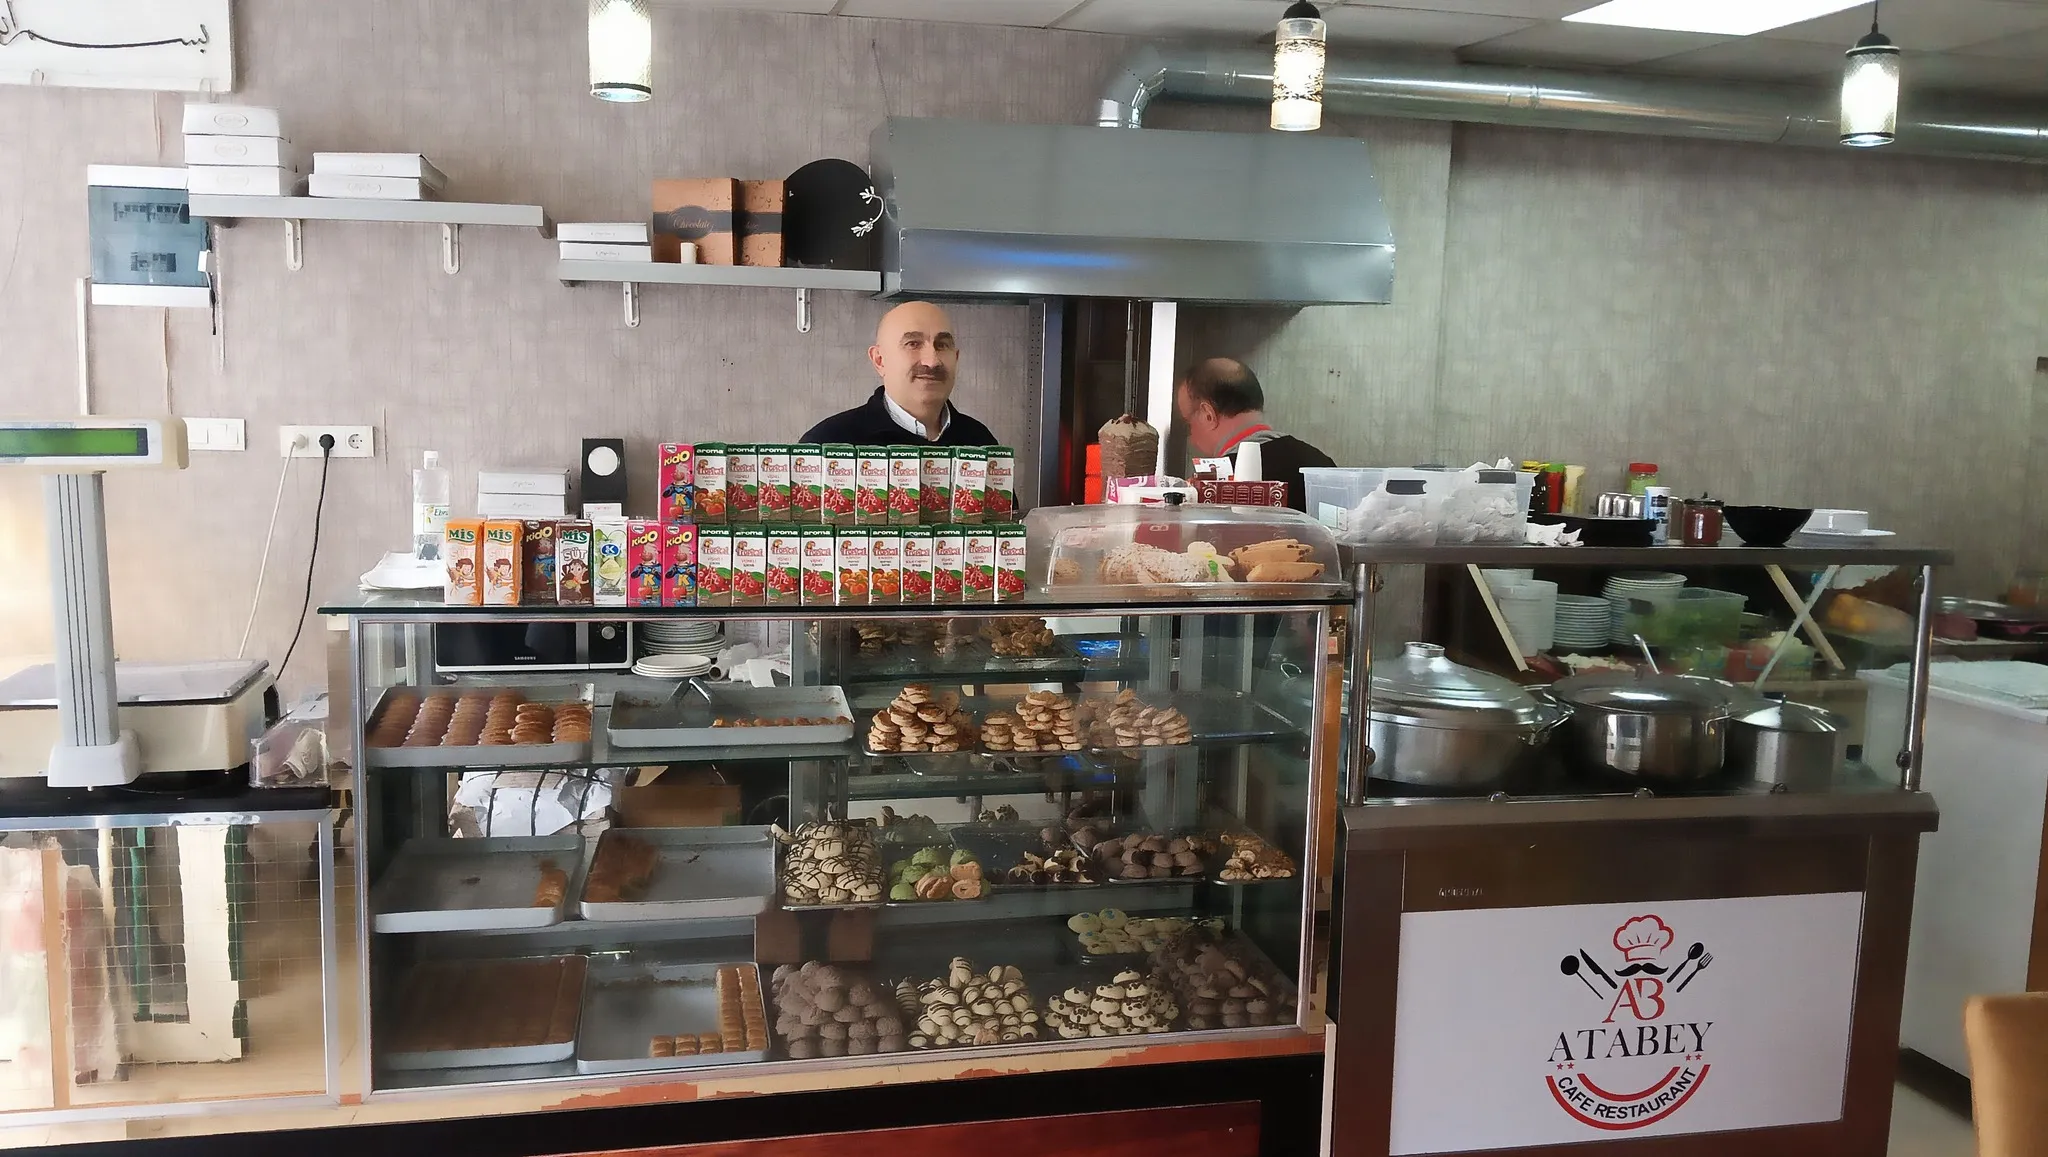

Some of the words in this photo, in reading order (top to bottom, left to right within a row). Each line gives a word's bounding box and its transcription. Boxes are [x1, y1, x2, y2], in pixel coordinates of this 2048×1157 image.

[1602, 977, 1665, 1024] AB
[1547, 1021, 1714, 1062] ATABEY
[1558, 1076, 1594, 1112] CAFE
[1593, 1067, 1696, 1119] RESTAURANT
